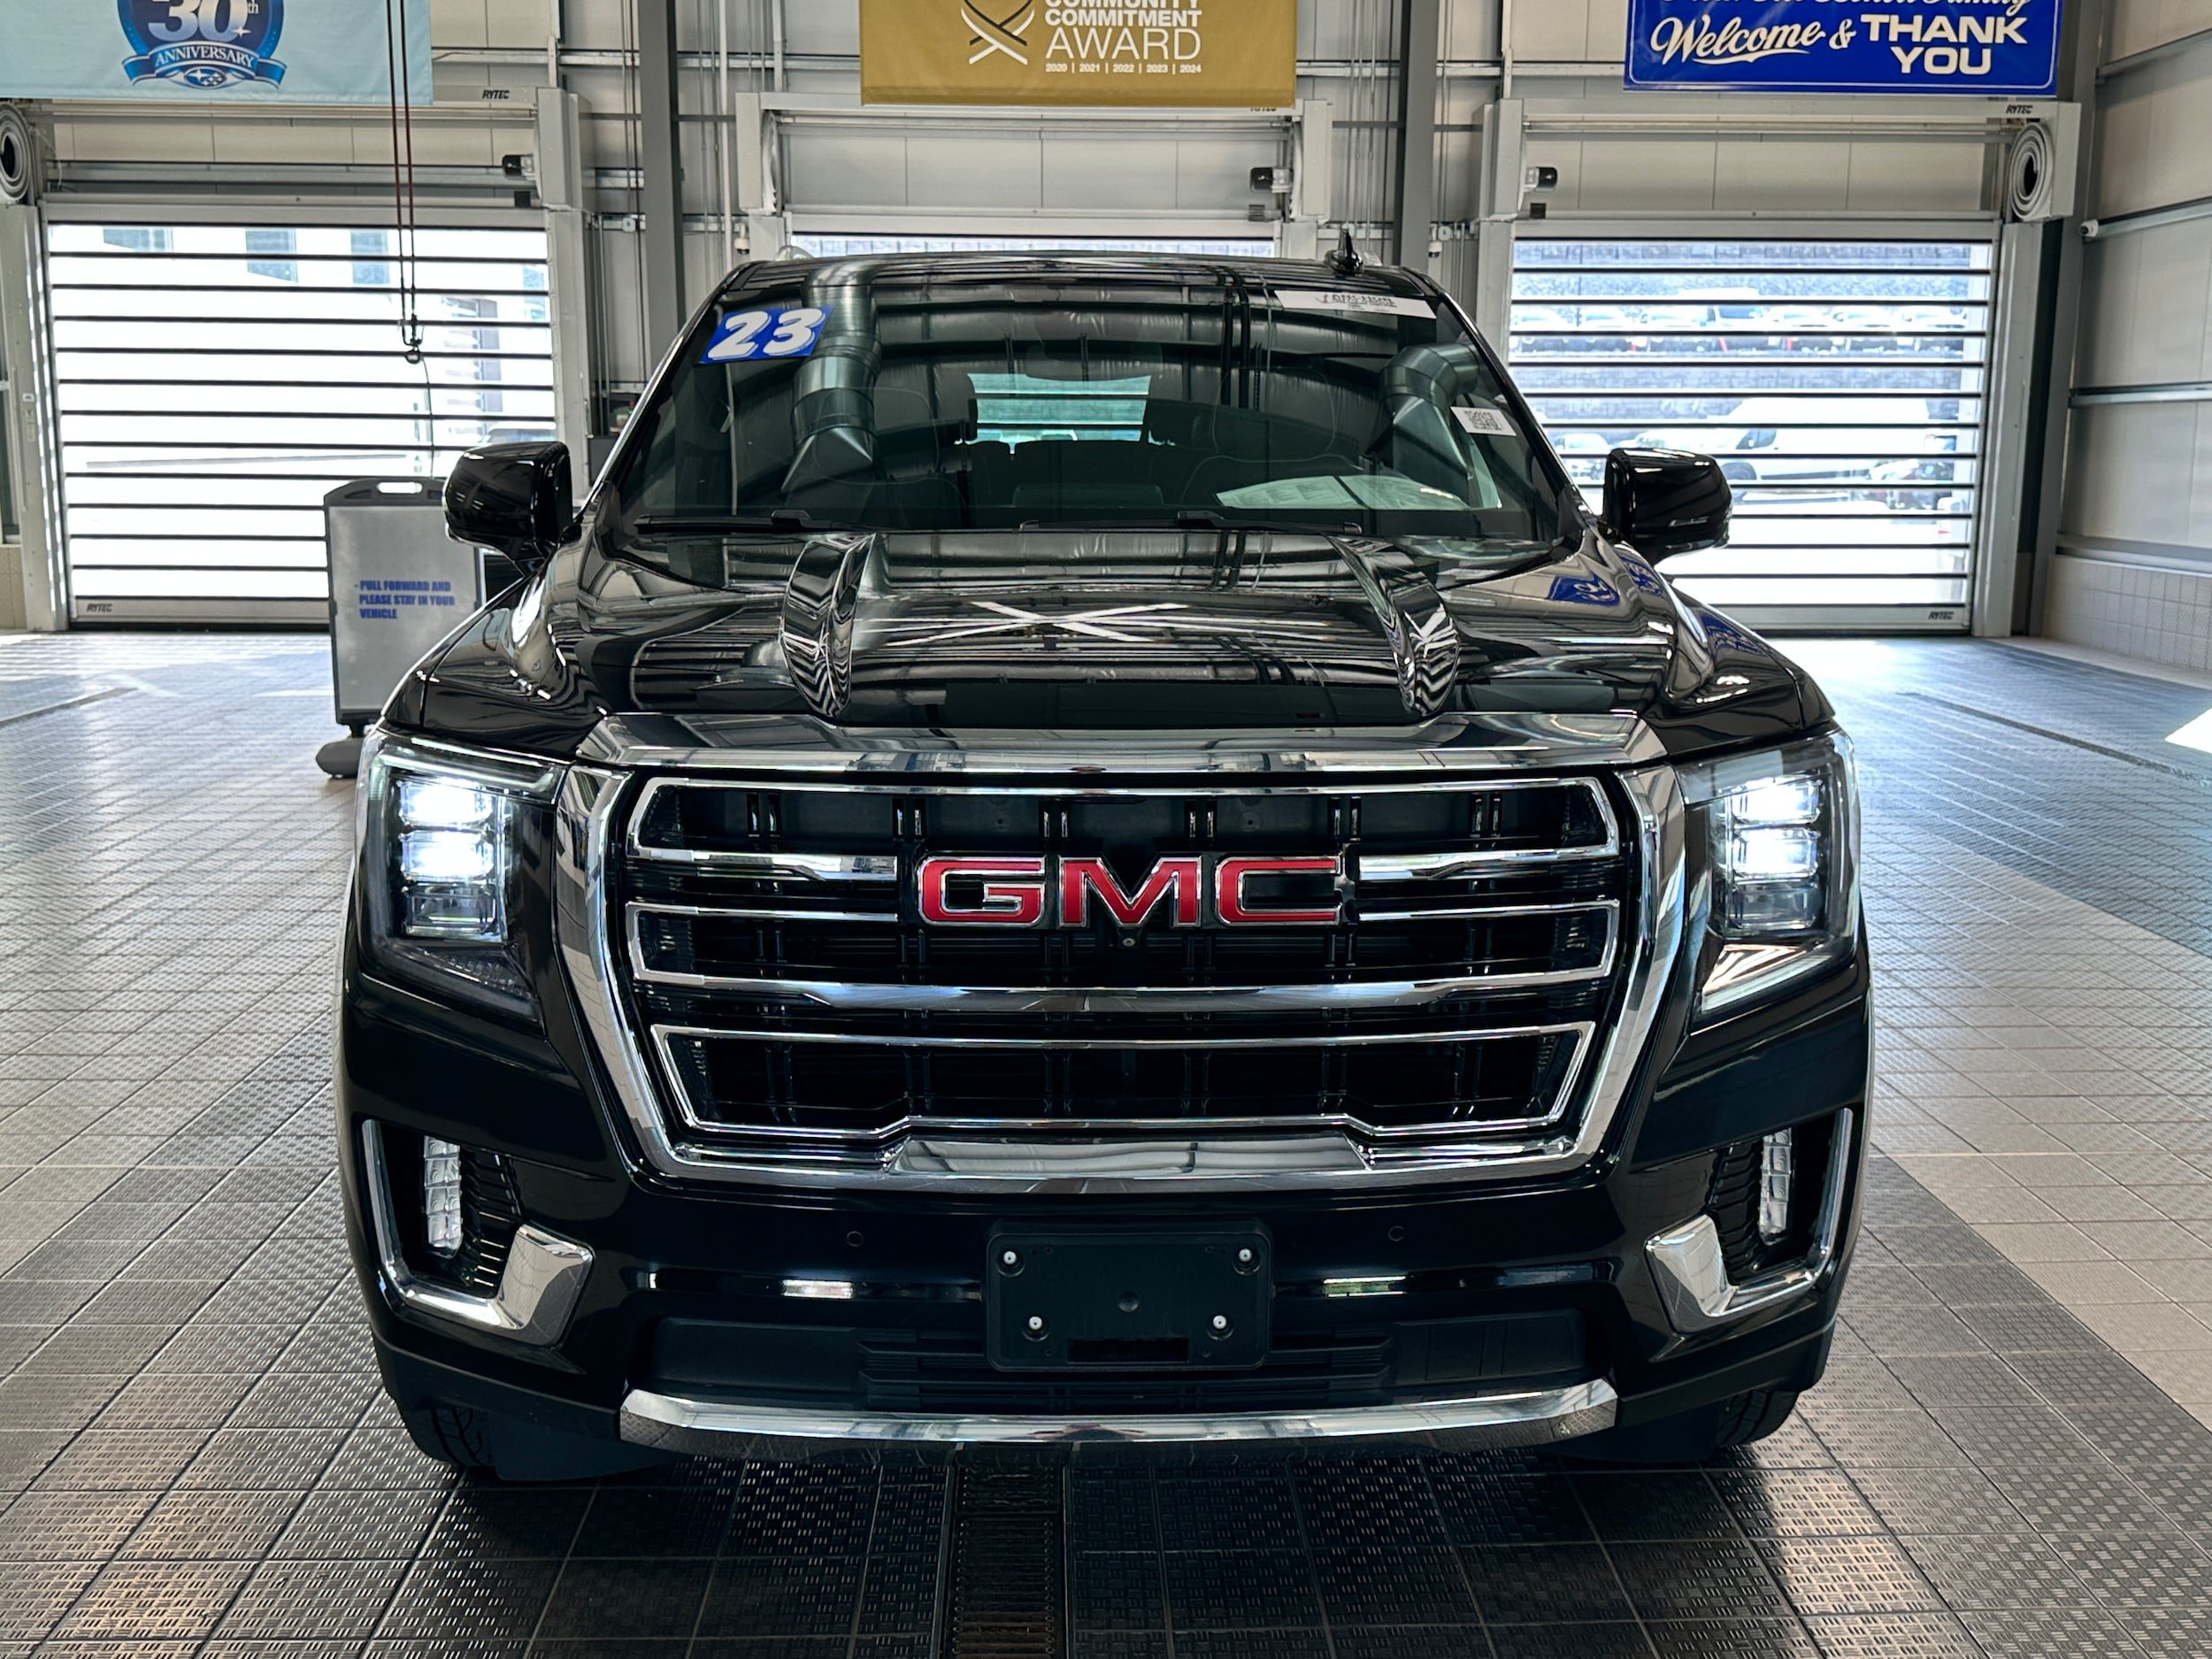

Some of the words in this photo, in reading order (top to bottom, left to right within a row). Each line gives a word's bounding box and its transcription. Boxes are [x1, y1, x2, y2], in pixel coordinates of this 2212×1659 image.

[1045, 9, 1202, 27] COMMITMENT
[1045, 27, 1202, 60] AWARD
[1650, 13, 1827, 65] Welcome
[1828, 19, 1856, 50] &
[1860, 14, 2028, 43] THANK
[154, 46, 256, 69] ANNIVERSARY
[1890, 46, 1991, 74] YOU
[1045, 63, 1068, 73] 2020
[1079, 63, 1101, 73] 2021
[1112, 64, 1135, 73] 2022
[1146, 64, 1169, 73] 2023
[1179, 65, 1202, 73] 2024
[482, 89, 511, 99] RYTEC
[2006, 104, 2033, 114] RYTEC
[708, 309, 826, 361] 23
[359, 580, 381, 591] PULL
[383, 580, 430, 591] FORWARD
[432, 581, 451, 592] AND
[359, 595, 392, 604] PLEASE
[394, 595, 416, 605] STAY
[418, 595, 428, 605] IN
[430, 595, 456, 606] YOUR
[359, 609, 397, 618] VEHICLE
[917, 855, 1343, 928] GMC
